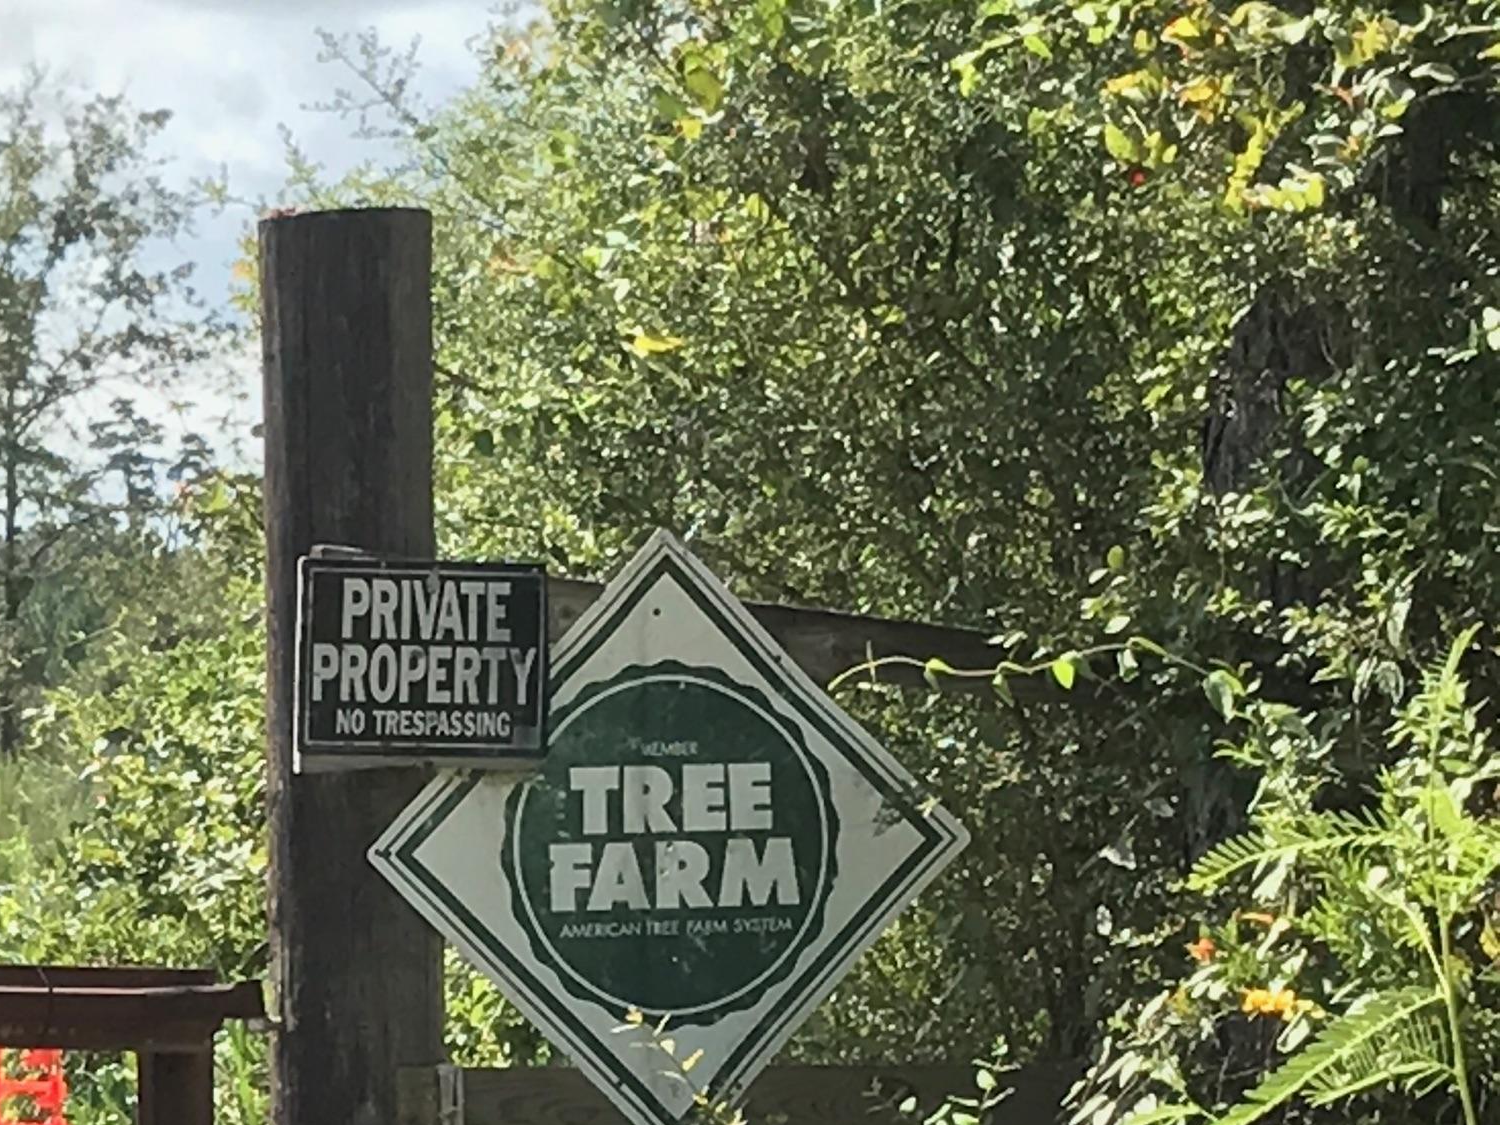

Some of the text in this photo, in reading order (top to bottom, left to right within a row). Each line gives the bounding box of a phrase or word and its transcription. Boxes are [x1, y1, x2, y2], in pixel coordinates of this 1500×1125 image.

[341, 578, 511, 642] PRIVATE
[312, 643, 536, 705] PROPERTY
[336, 708, 511, 737] NO TRESPASSING
[569, 762, 773, 835] TREE
[548, 837, 800, 912] FARM
[560, 917, 793, 938] AMERICAN TREE FARM SYSTEM
